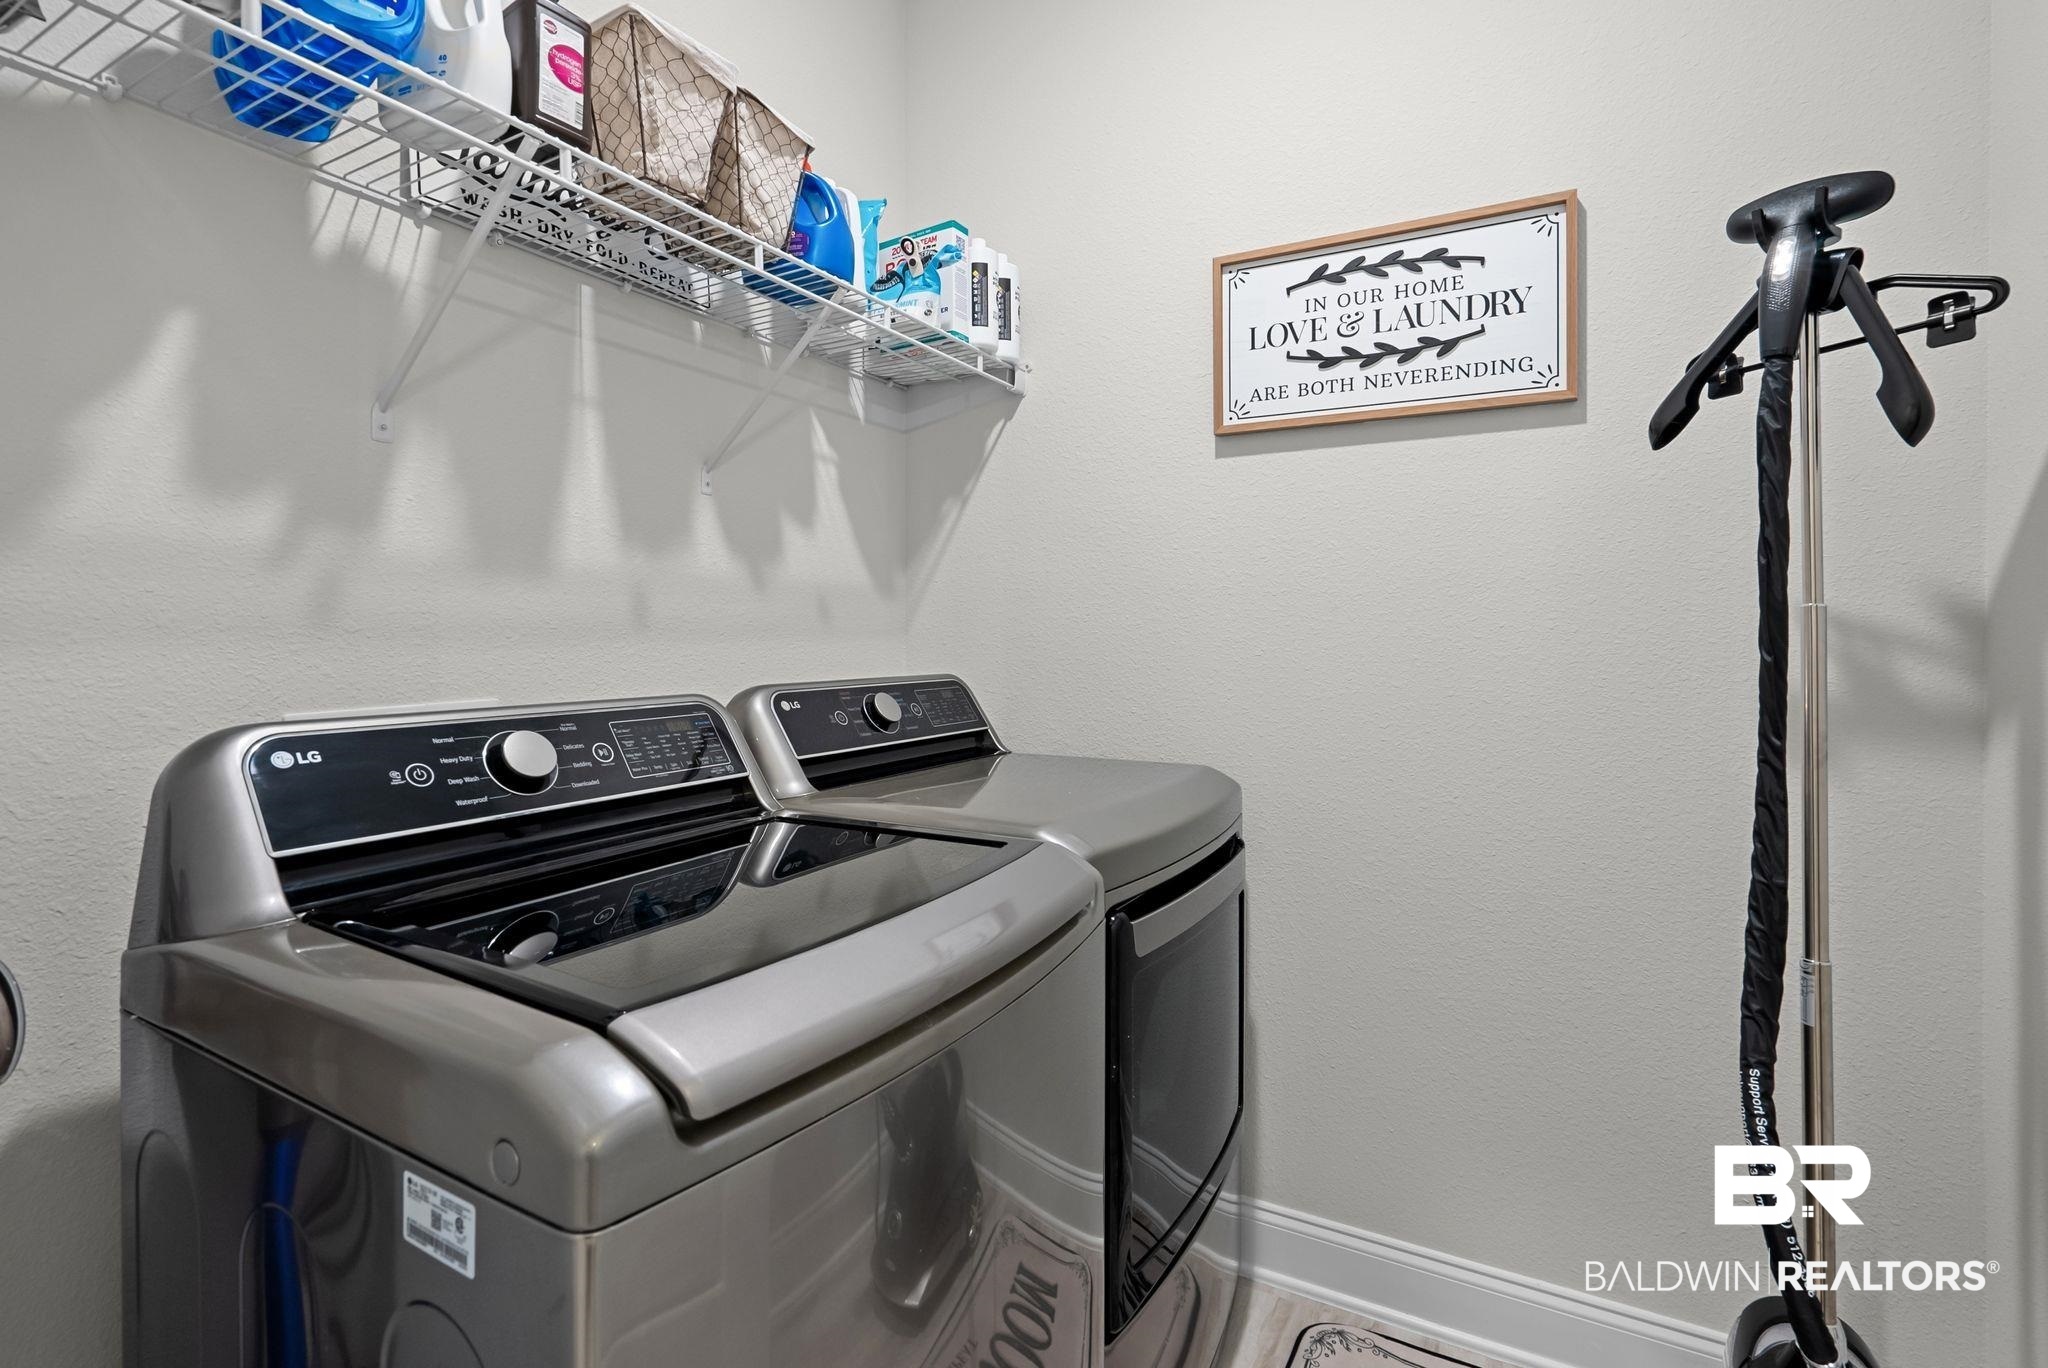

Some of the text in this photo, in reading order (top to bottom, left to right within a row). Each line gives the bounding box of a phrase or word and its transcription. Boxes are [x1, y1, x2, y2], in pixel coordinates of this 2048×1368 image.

[537, 217, 573, 244] DRY
[586, 237, 629, 265] FOLD
[1304, 274, 1465, 313] IN OUR HOME
[1249, 285, 1534, 351] LOVE & LAUNDRY
[1249, 356, 1535, 403] ARE BOTH NEVERENDING
[789, 701, 801, 709] LG
[432, 736, 455, 744] Normal
[295, 750, 322, 765] LG
[459, 755, 473, 763] Duty
[463, 775, 480, 783] Wash
[455, 796, 488, 806] Waterproof
[1748, 1068, 1766, 1116] Support
